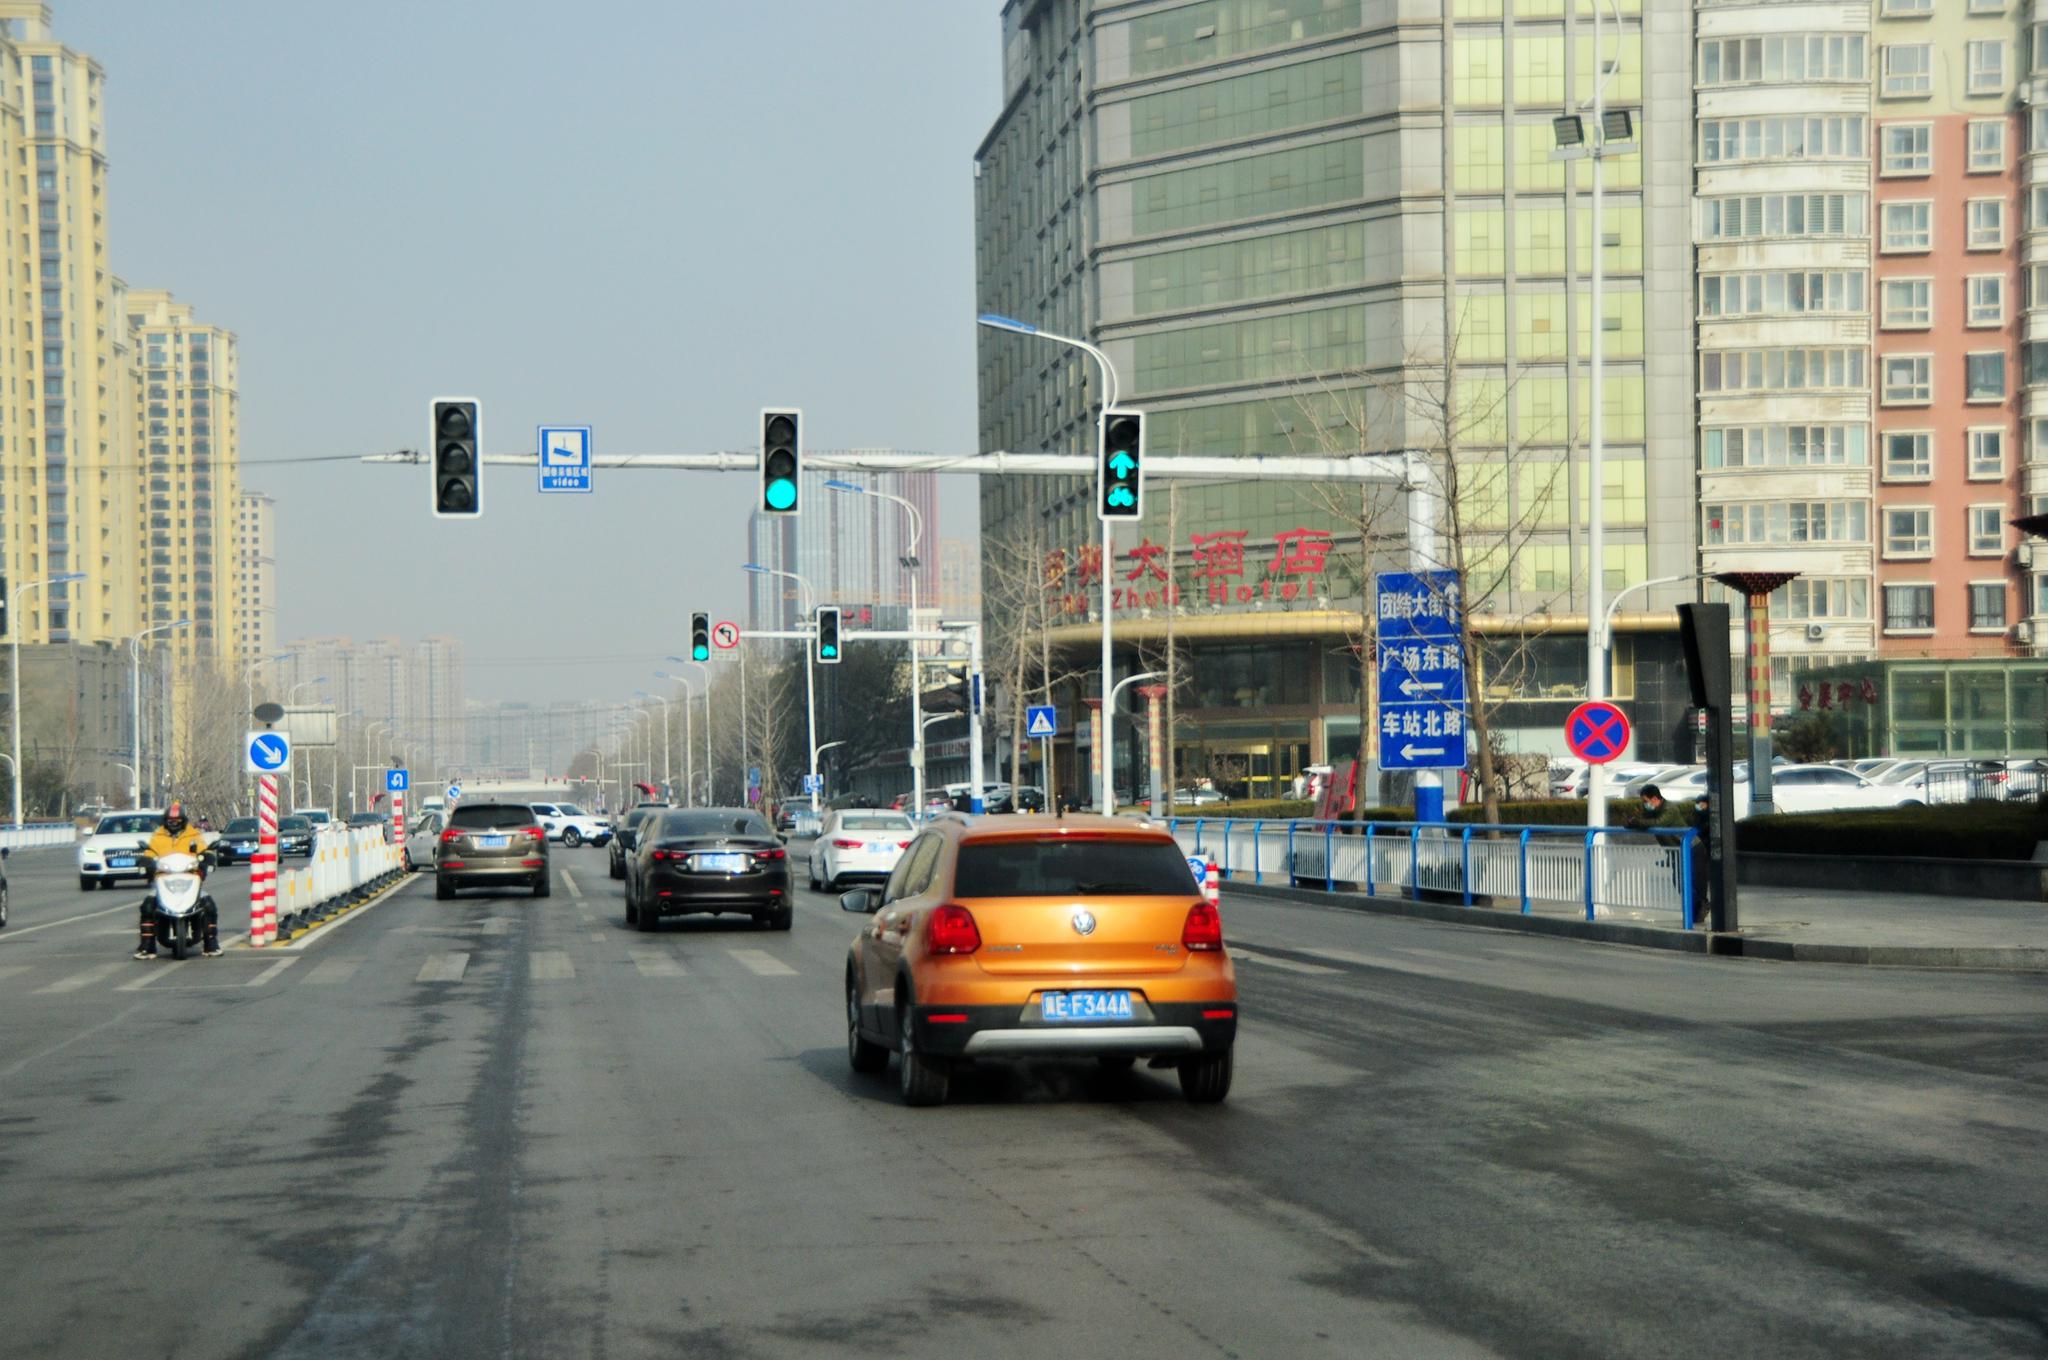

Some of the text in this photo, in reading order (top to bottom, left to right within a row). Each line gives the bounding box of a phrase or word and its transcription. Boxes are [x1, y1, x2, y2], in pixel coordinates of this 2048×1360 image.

[552, 476, 579, 487] video
[1379, 592, 1443, 619] 团结大街
[1381, 643, 1461, 673] 广场东路
[1381, 709, 1462, 737] 车站北路
